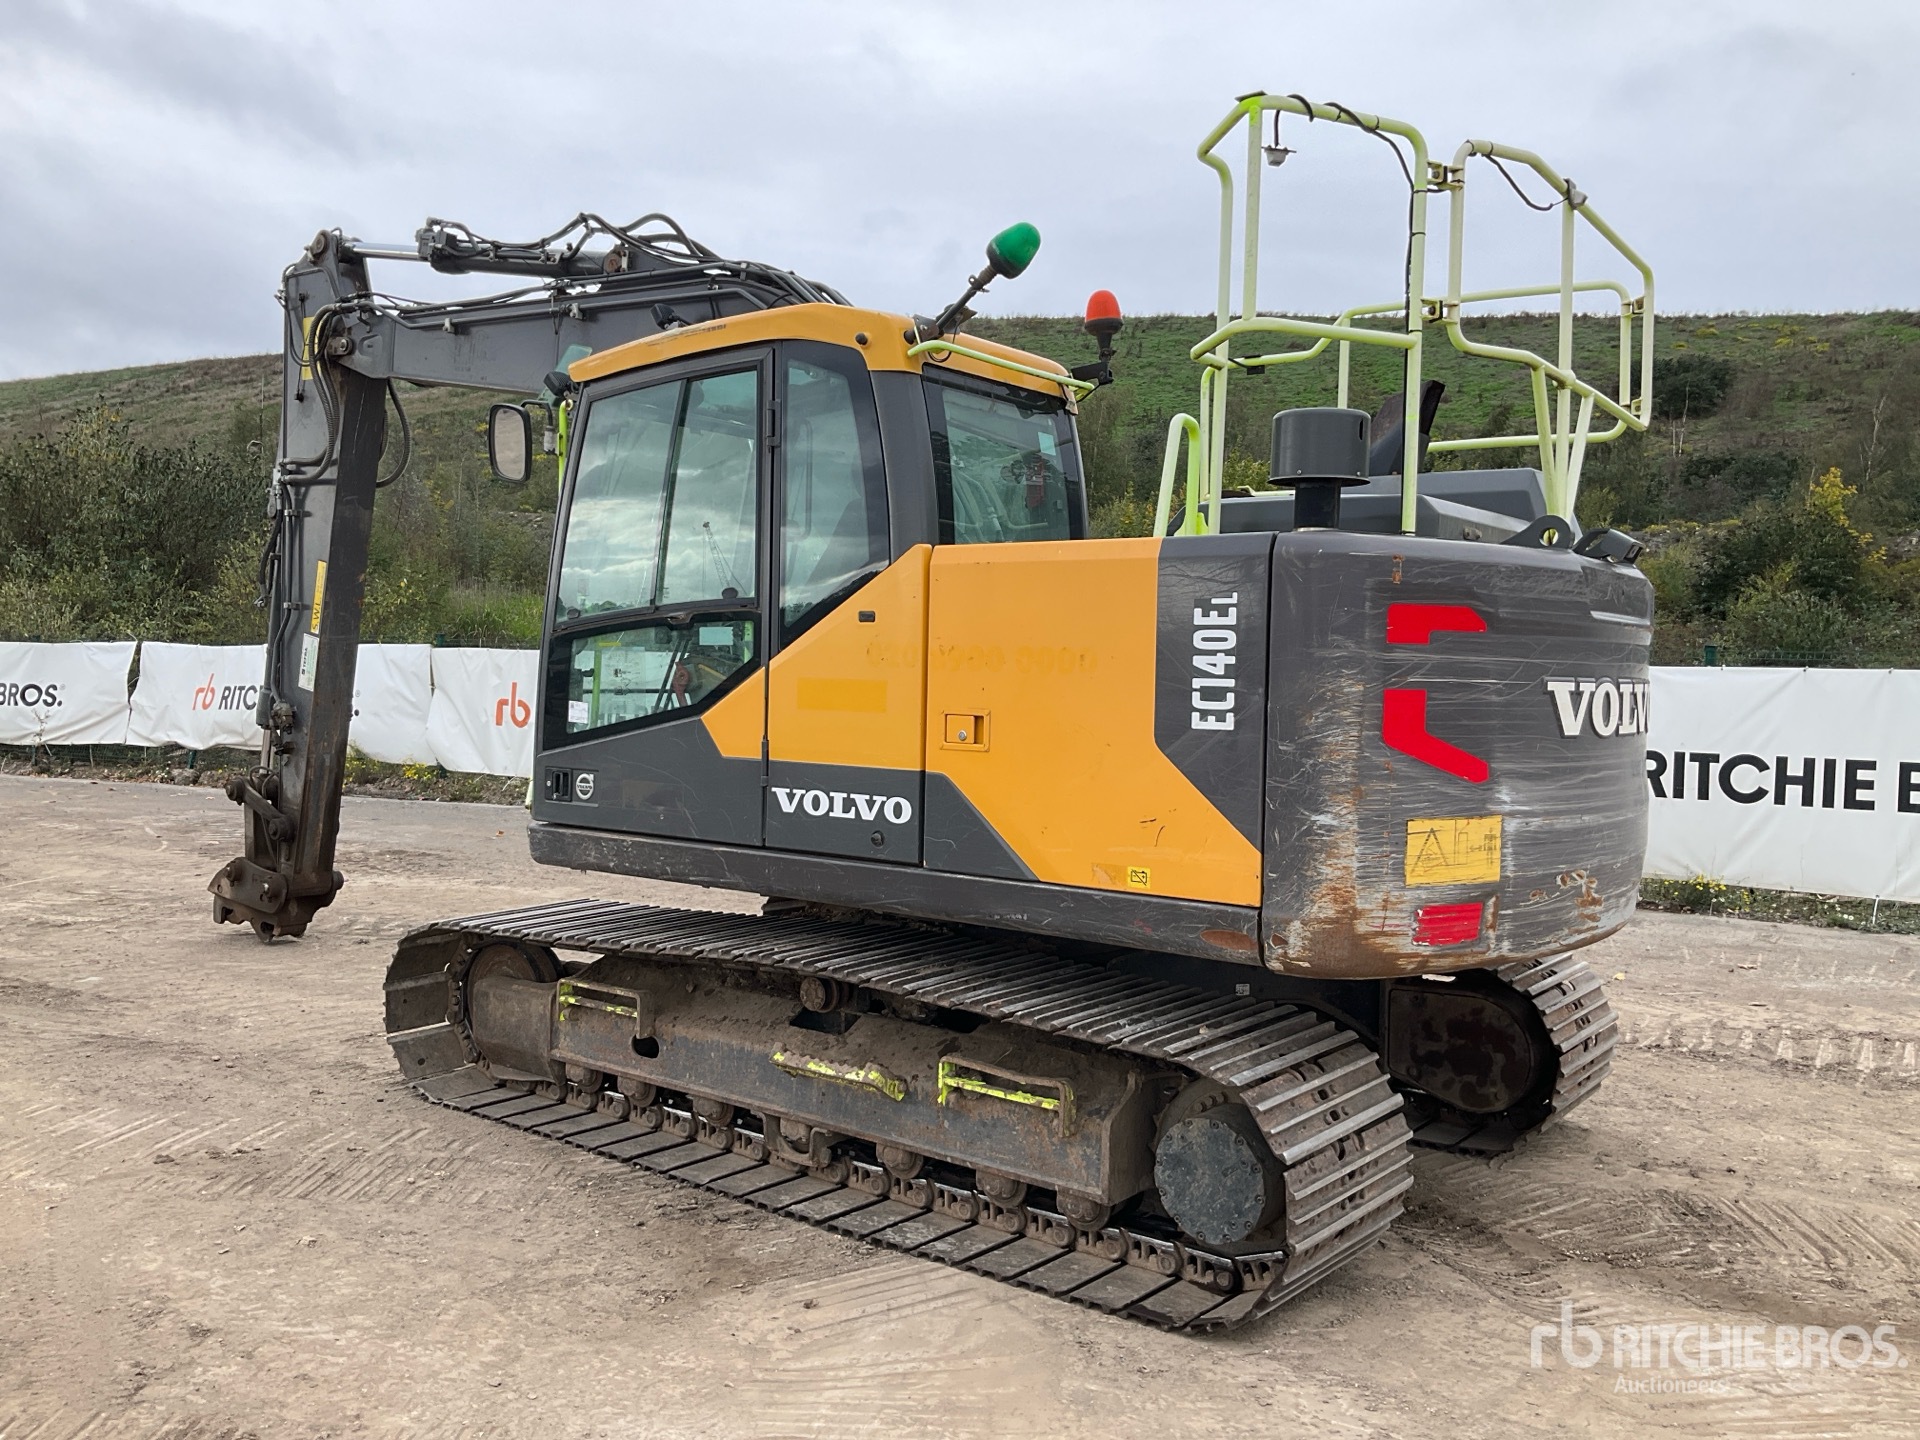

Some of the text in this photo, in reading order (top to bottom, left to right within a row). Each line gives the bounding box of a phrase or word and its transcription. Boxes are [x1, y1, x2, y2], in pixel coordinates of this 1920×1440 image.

[1191, 591, 1238, 730] EC140EL
[218, 685, 258, 710] RITC
[496, 682, 531, 728] rb
[1545, 678, 1650, 737] VOLV
[771, 787, 912, 824] VOLVO
[1646, 750, 1877, 811] RITCHIE
